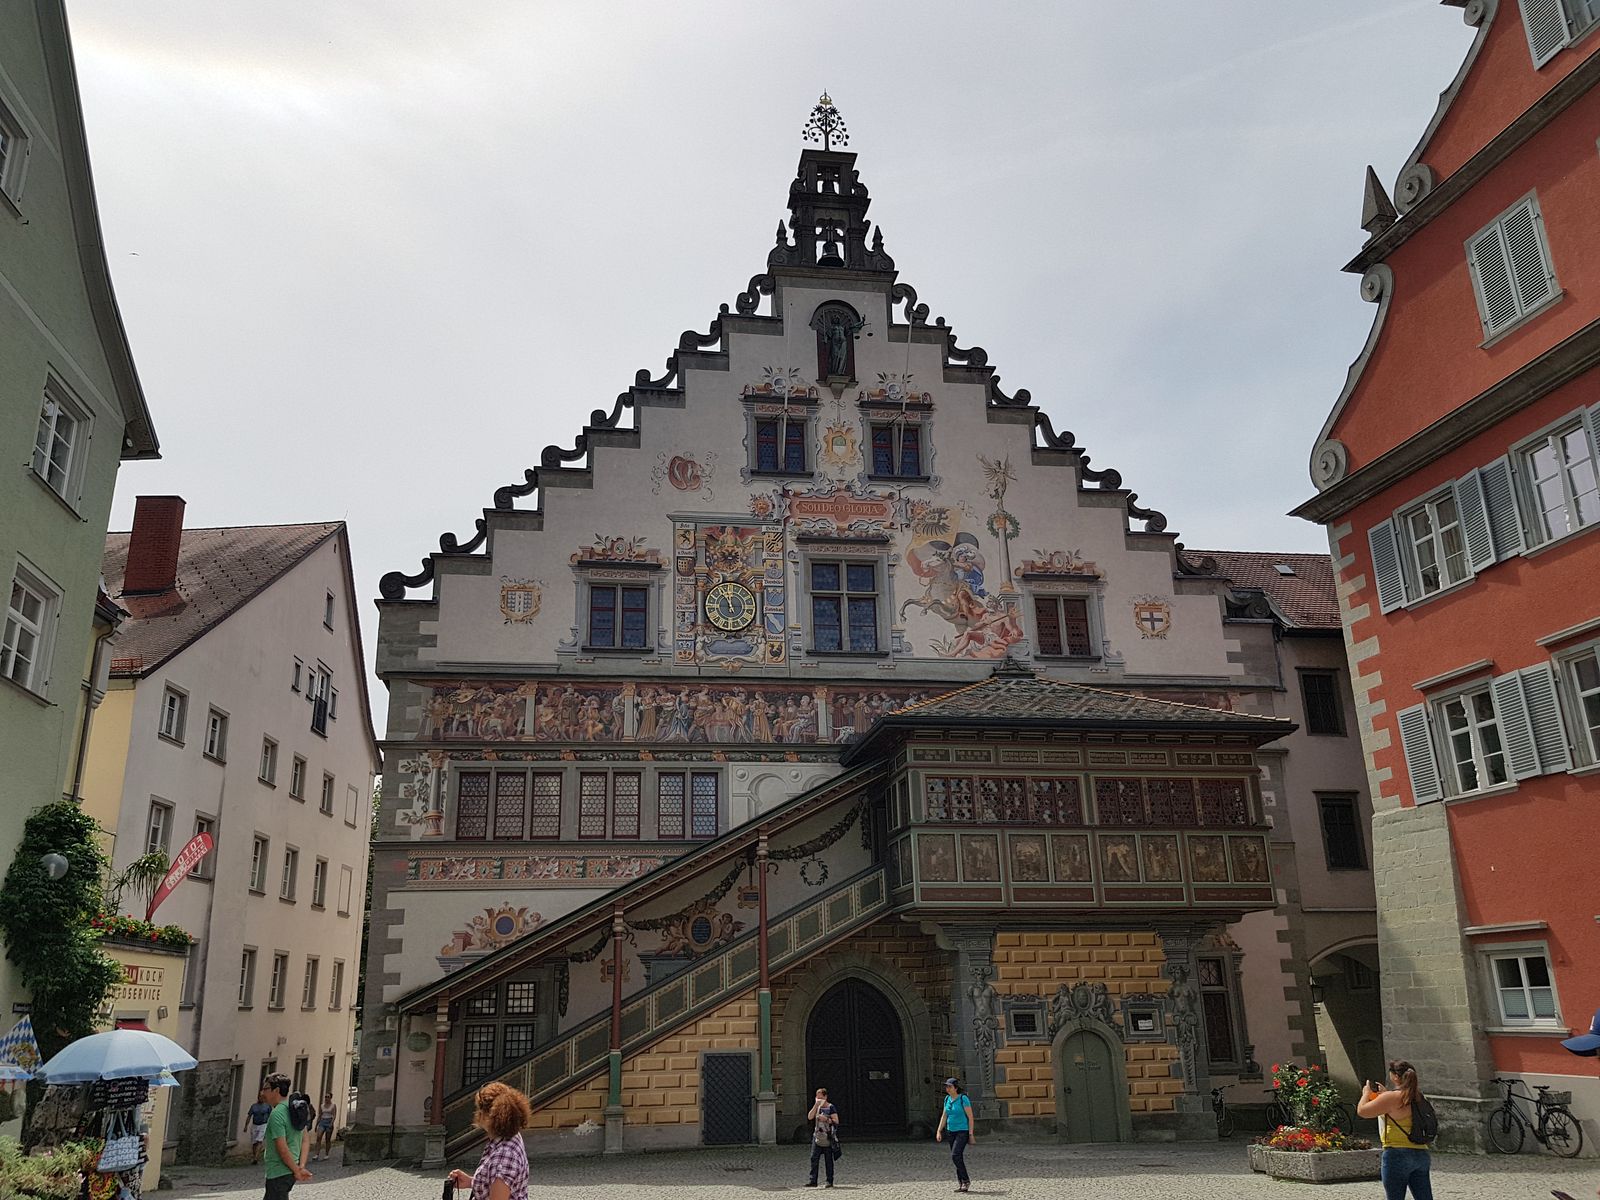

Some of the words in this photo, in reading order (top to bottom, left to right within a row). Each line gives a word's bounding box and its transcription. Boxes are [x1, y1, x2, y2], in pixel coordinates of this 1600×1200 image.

[802, 502, 821, 513] SOLI
[822, 502, 840, 513] DEO
[843, 503, 878, 515] GLORIA
[139, 968, 162, 982] KOCH
